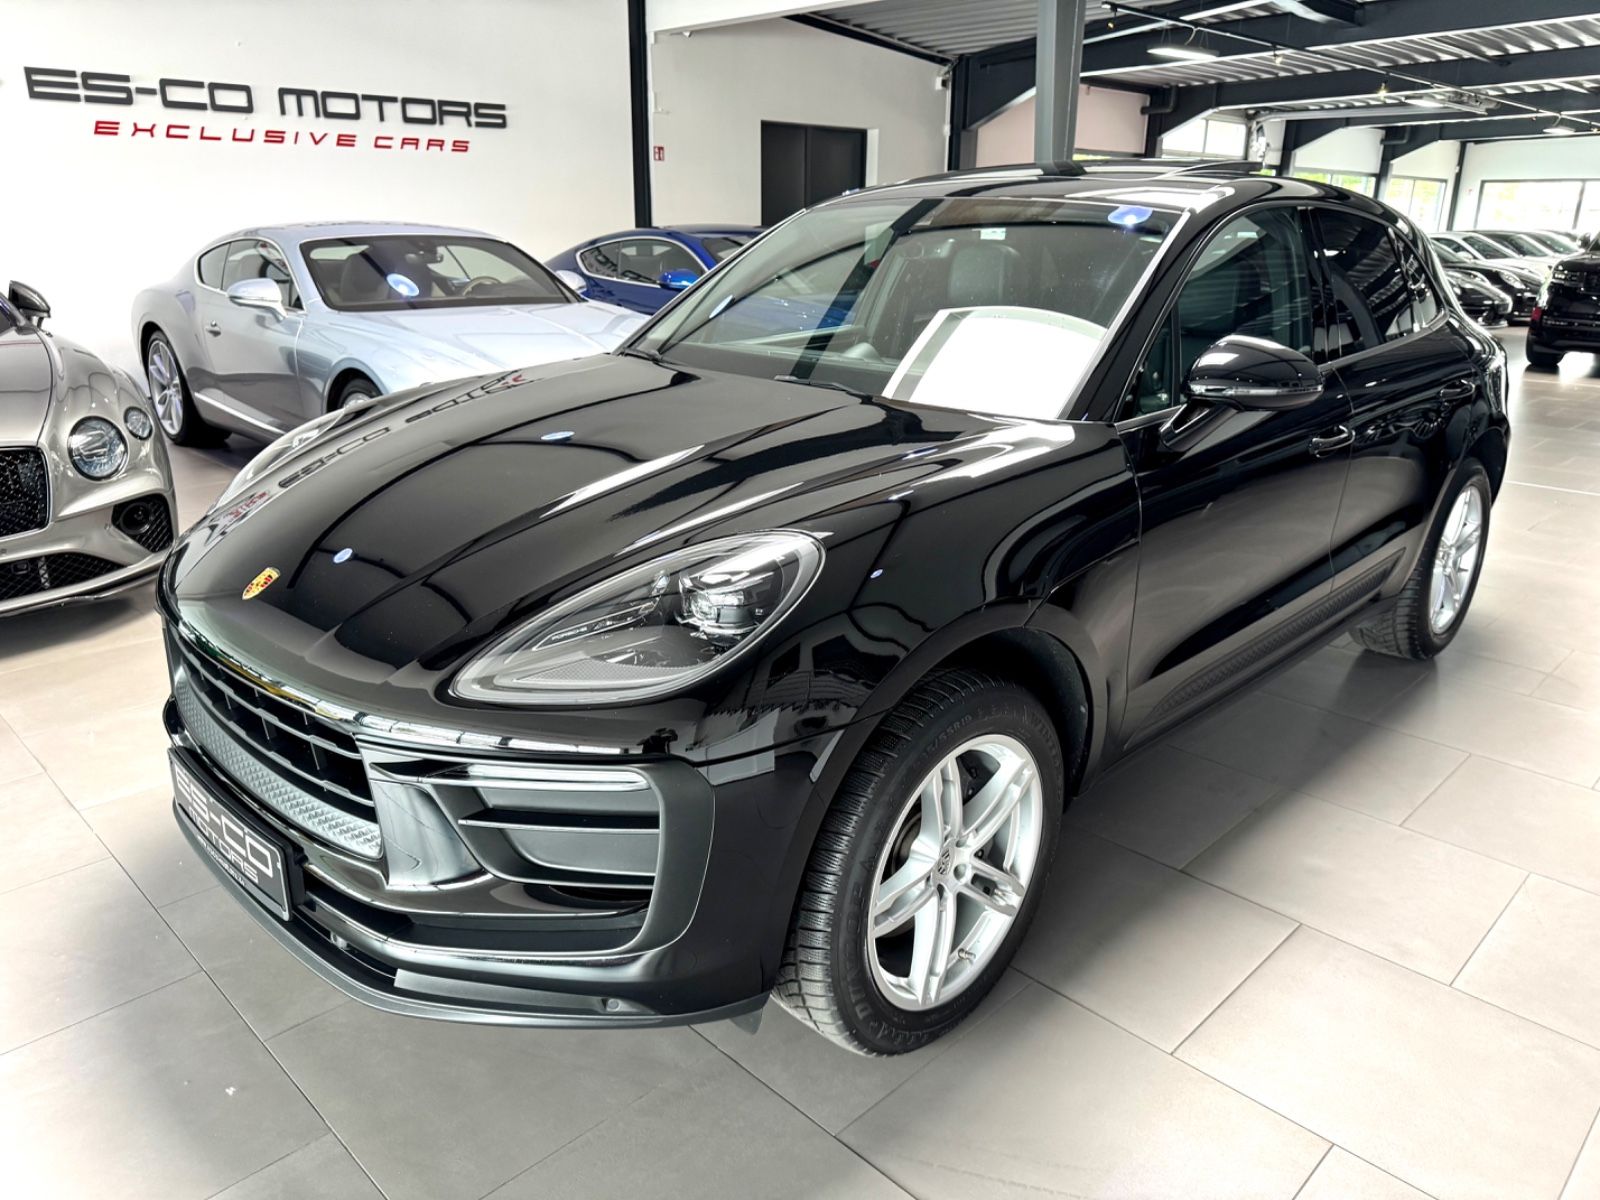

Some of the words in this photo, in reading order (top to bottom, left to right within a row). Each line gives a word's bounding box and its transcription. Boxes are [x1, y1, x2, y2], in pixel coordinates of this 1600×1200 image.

[24, 66, 254, 114] ES-CO
[278, 87, 507, 129] MOTORS
[94, 120, 357, 147] EXCLUSIVE
[374, 135, 471, 153] CARS
[175, 763, 273, 878] ES-CO
[189, 806, 259, 884] MOTORS
